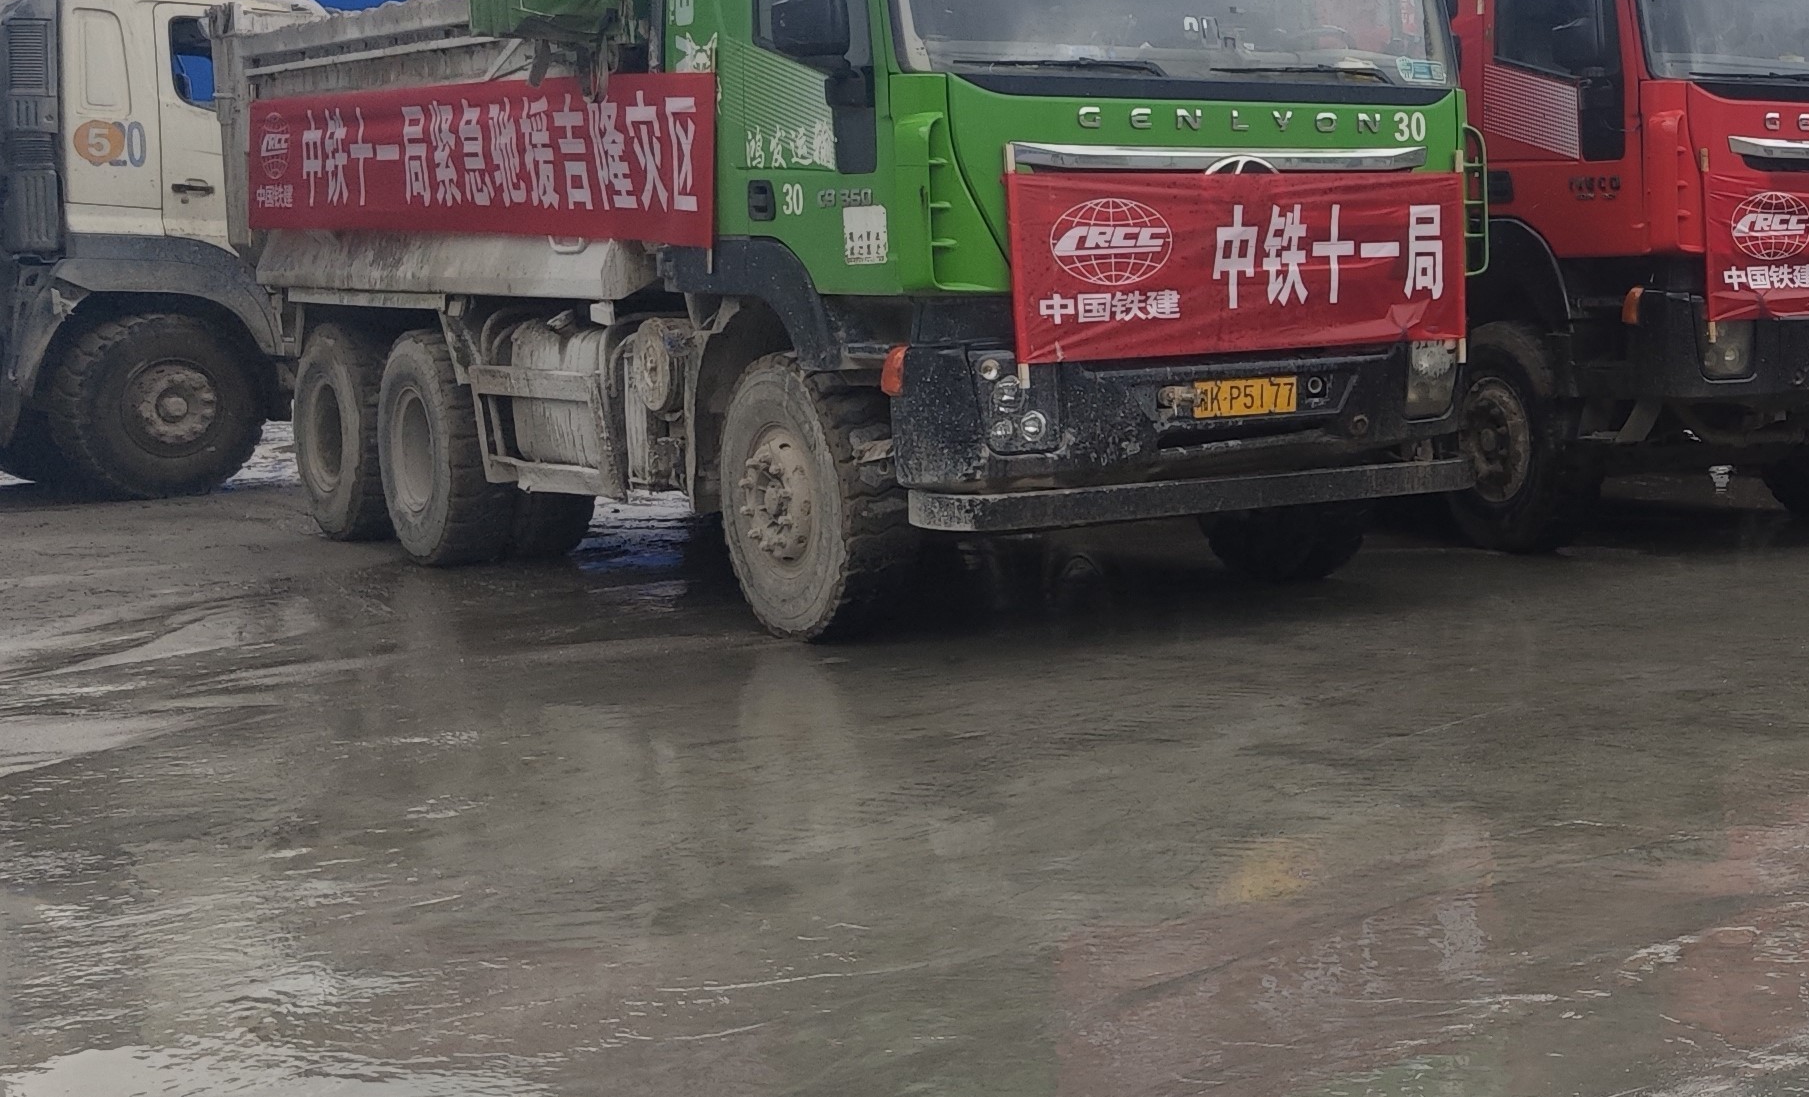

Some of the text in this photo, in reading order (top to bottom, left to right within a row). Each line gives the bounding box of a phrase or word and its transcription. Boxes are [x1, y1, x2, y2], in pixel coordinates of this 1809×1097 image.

[1078, 106, 1426, 142] GENLYON 30
[302, 90, 699, 212] 中铁十一局紧急驰援吉隆灾区
[782, 183, 804, 216] 30
[1212, 204, 1444, 309] 中铁十一局
[1039, 289, 1181, 325] 中国铁建
